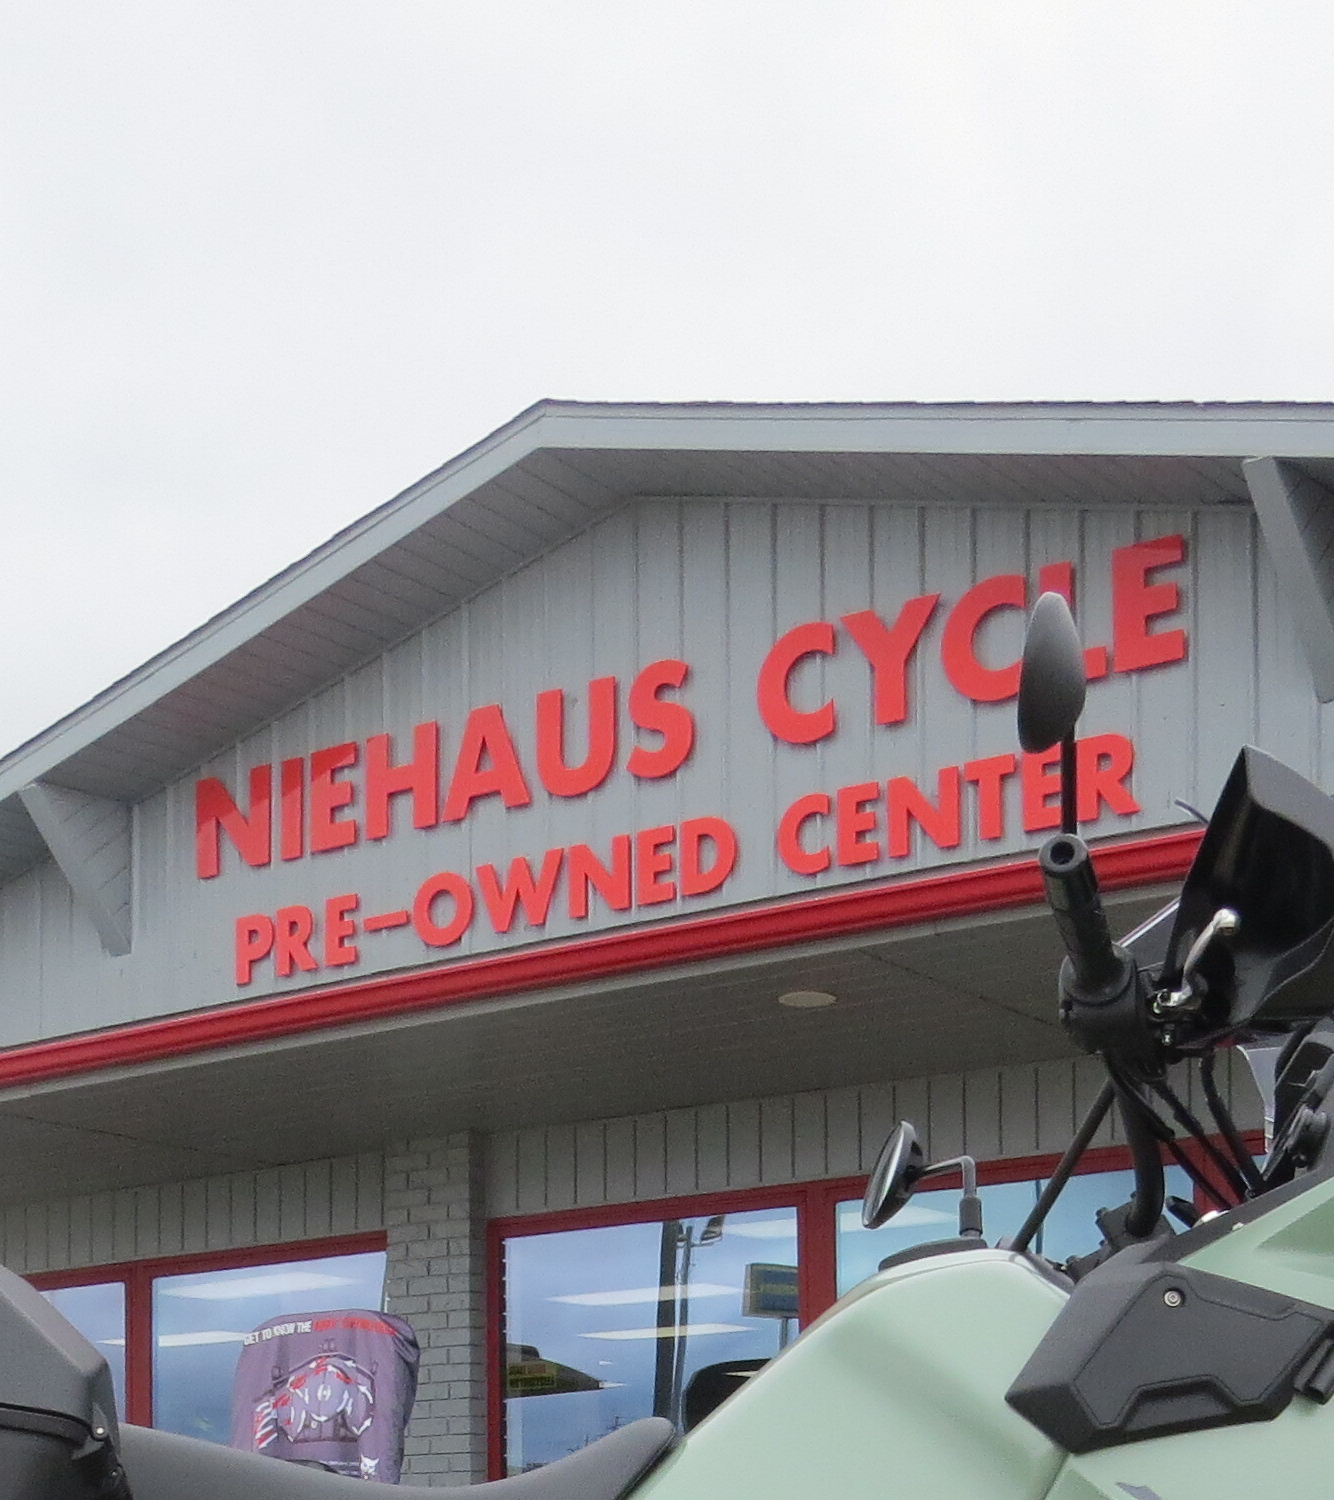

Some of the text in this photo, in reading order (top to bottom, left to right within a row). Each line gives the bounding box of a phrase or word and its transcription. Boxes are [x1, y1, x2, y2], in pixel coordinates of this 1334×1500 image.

[196, 660, 695, 879] NIEHAUS
[235, 733, 1141, 985] PRE-OWNED CENTER
[244, 1331, 260, 1345] GET
[261, 1328, 273, 1341] TO
[272, 1322, 296, 1338] KNOW
[295, 1320, 313, 1333] THE
